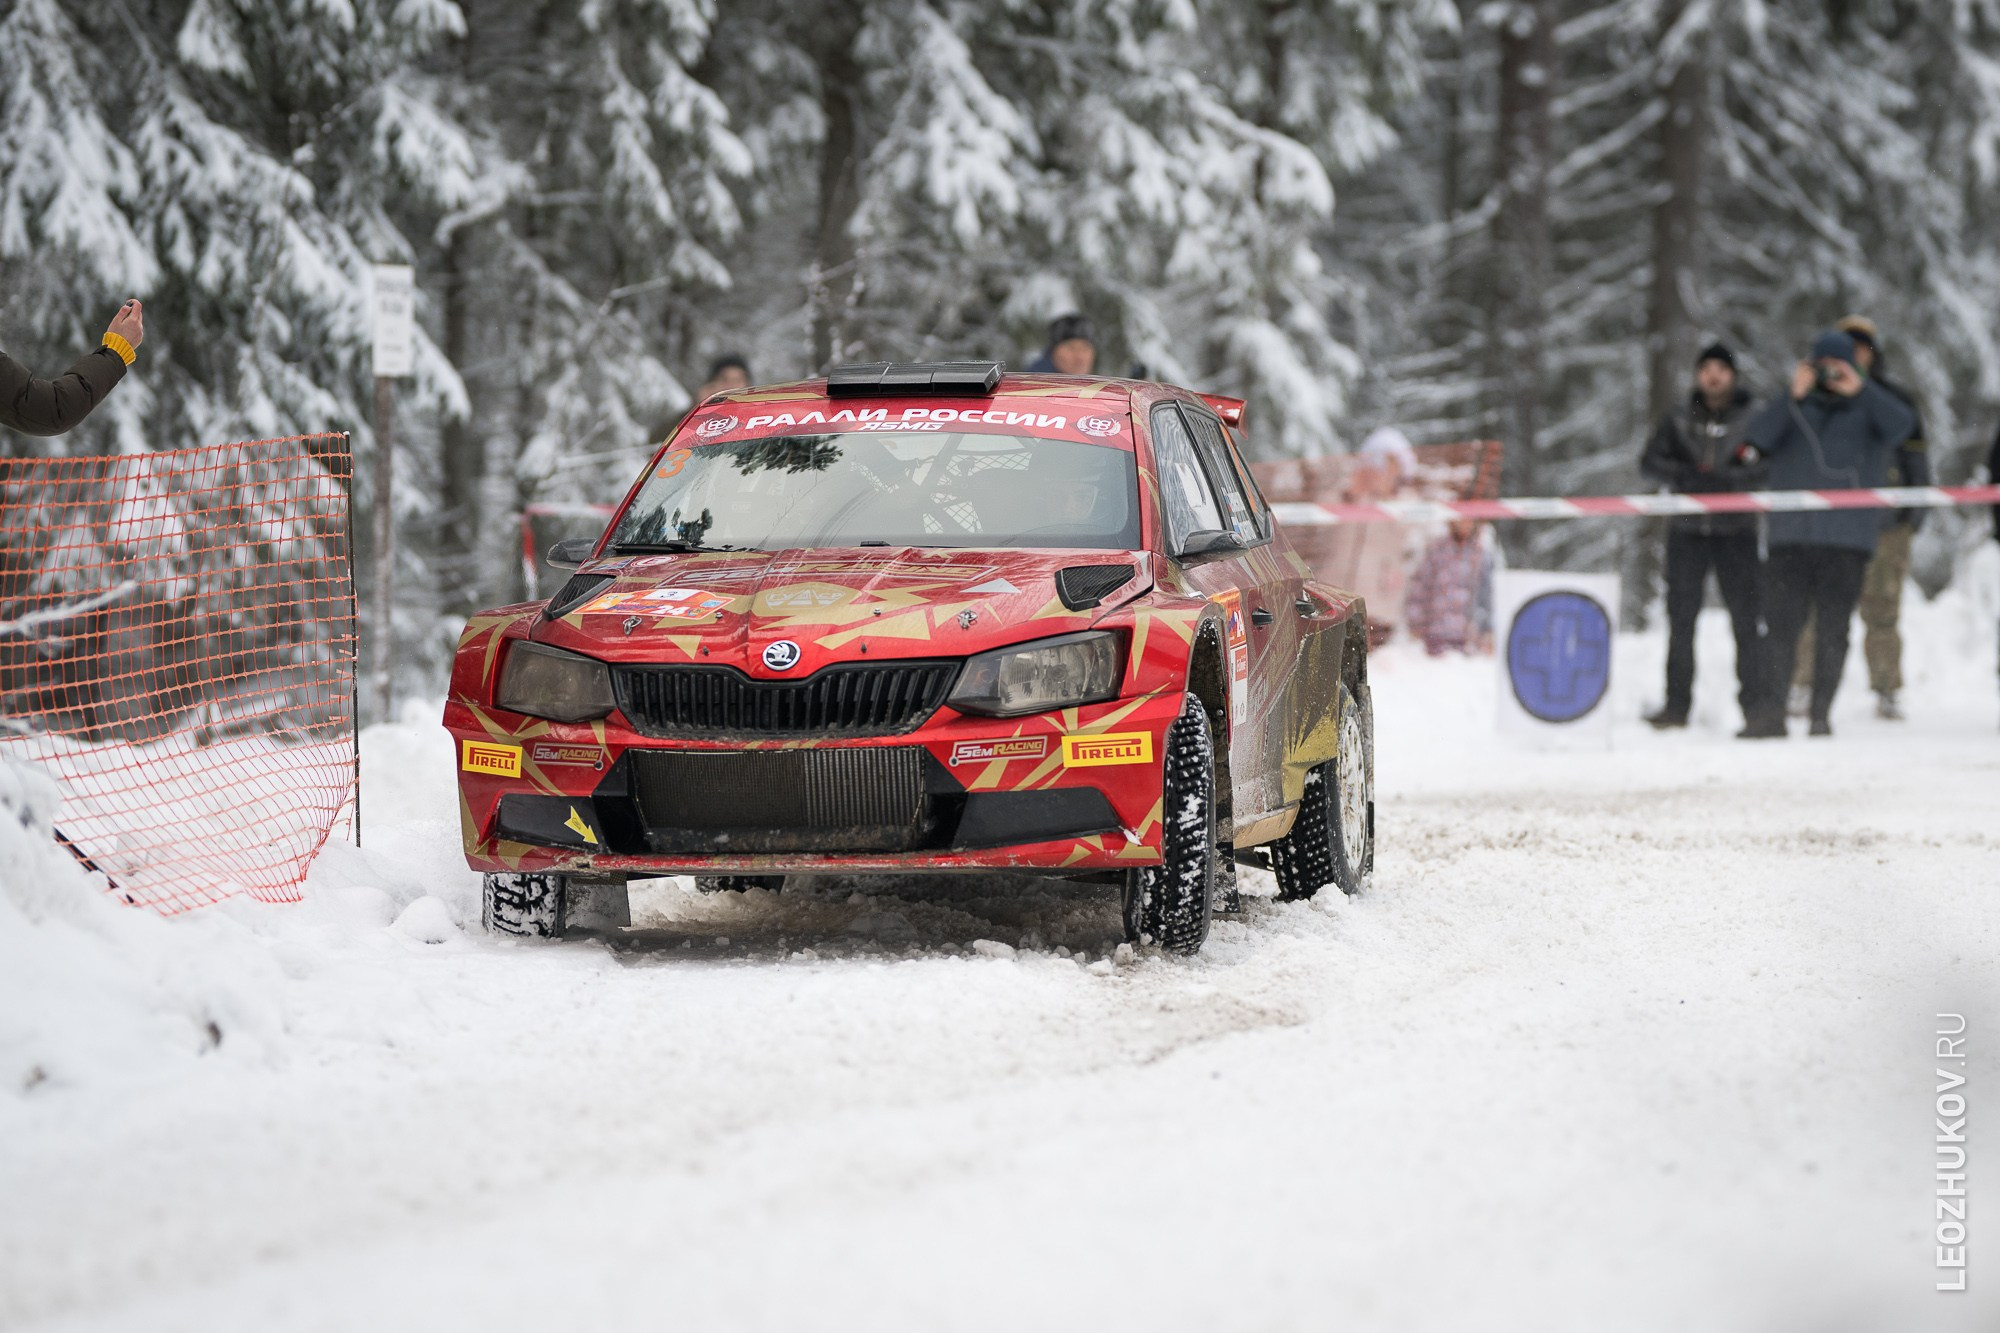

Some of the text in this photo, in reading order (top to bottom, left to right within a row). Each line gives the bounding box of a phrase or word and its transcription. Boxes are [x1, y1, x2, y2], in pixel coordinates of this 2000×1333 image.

[745, 408, 1067, 430] РАЛЛИ РОССИИ
[656, 449, 692, 478] 3
[649, 604, 690, 616] 24
[468, 746, 516, 771] PIRELLI
[1071, 738, 1142, 760] PIRELLI
